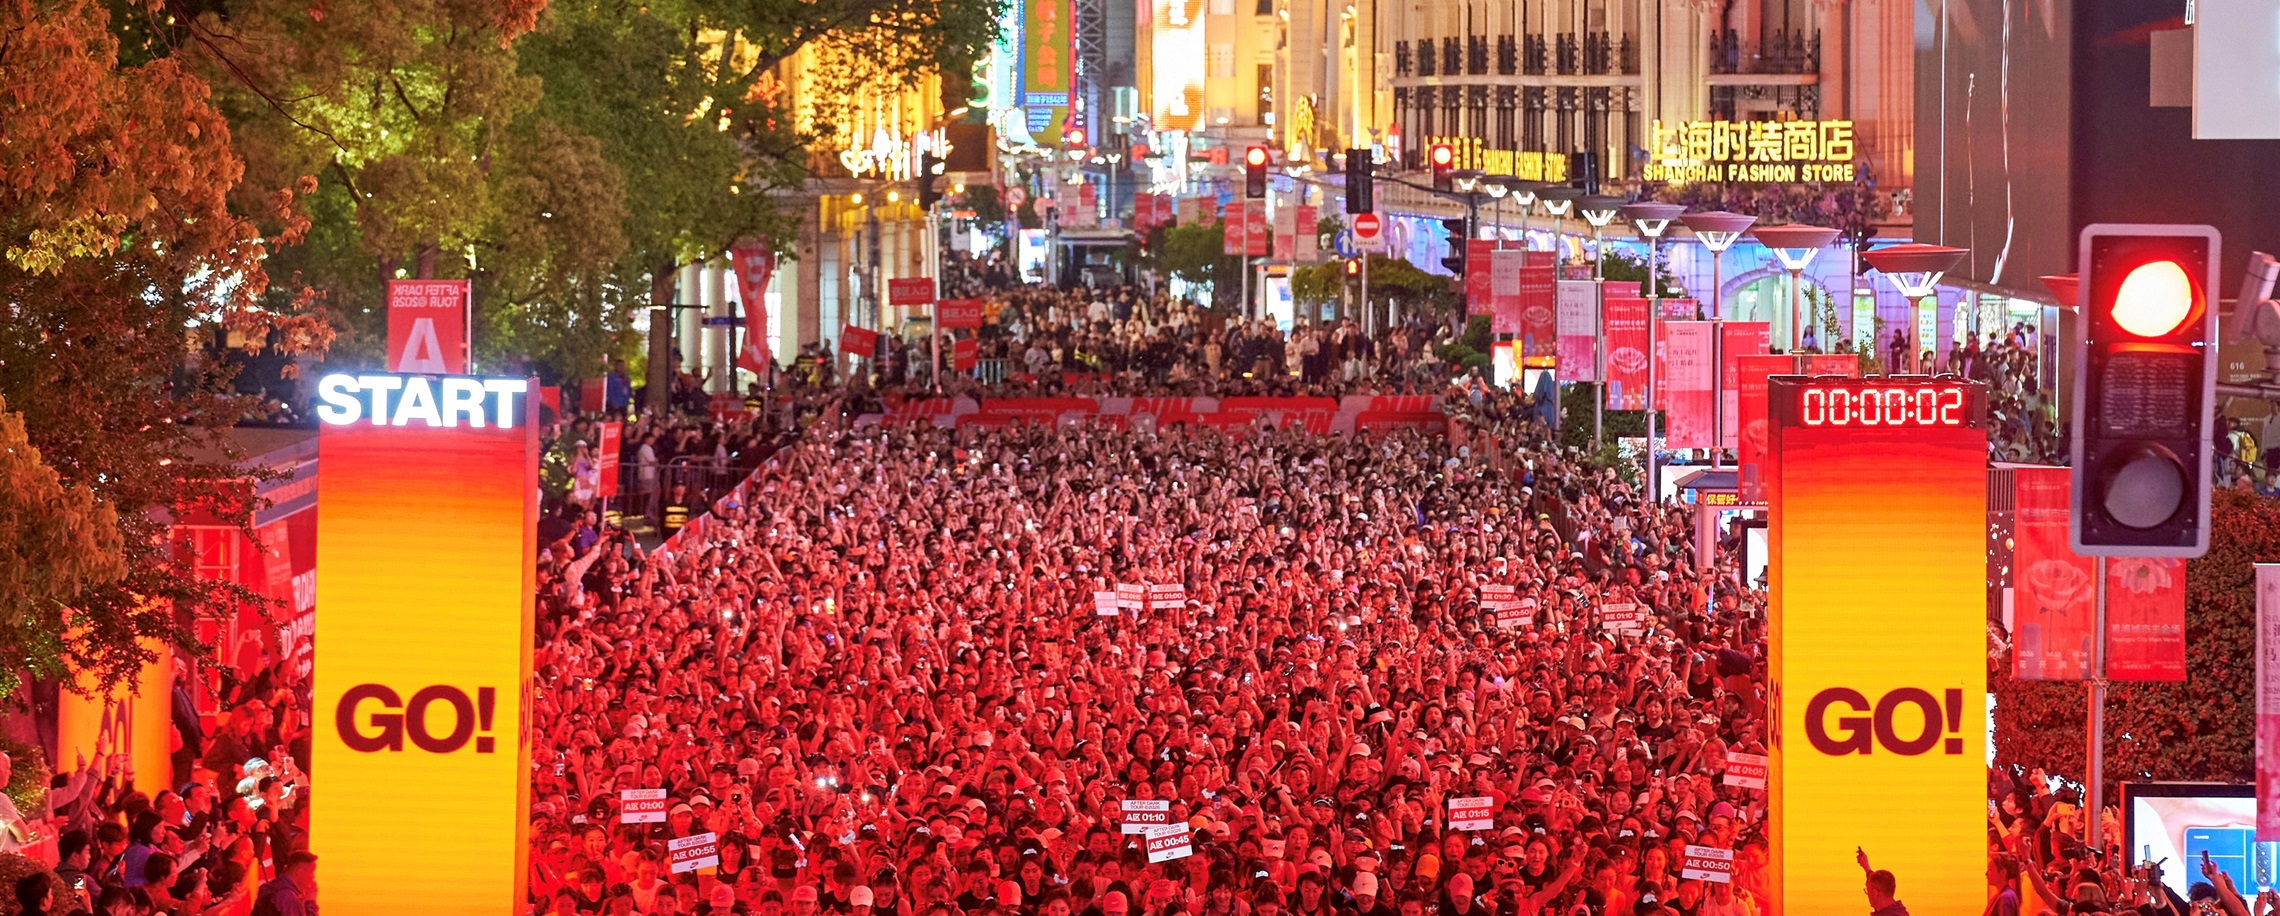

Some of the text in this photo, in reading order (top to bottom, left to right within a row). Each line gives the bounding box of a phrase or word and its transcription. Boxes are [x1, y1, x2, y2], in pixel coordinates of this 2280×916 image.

[1653, 119, 1853, 162] 上海时装商店
[1483, 149, 1566, 183] SHANGHAI FASHION STORE
[1643, 164, 1853, 182] SHANGHAI FASHION STORE
[318, 373, 527, 428] START
[1804, 389, 1963, 425] 00:00:02
[336, 684, 496, 754] GO!
[1805, 687, 1964, 756] GO!
[1742, 766, 1764, 776] 01:05
[625, 801, 664, 811] A区 01:00
[1453, 809, 1490, 819] A区 01:15
[1126, 813, 1165, 821] A区 01:10
[1150, 835, 1189, 850] A区 00:45
[672, 845, 715, 861] A区 00:55
[1686, 859, 1730, 870] A区 00:50
